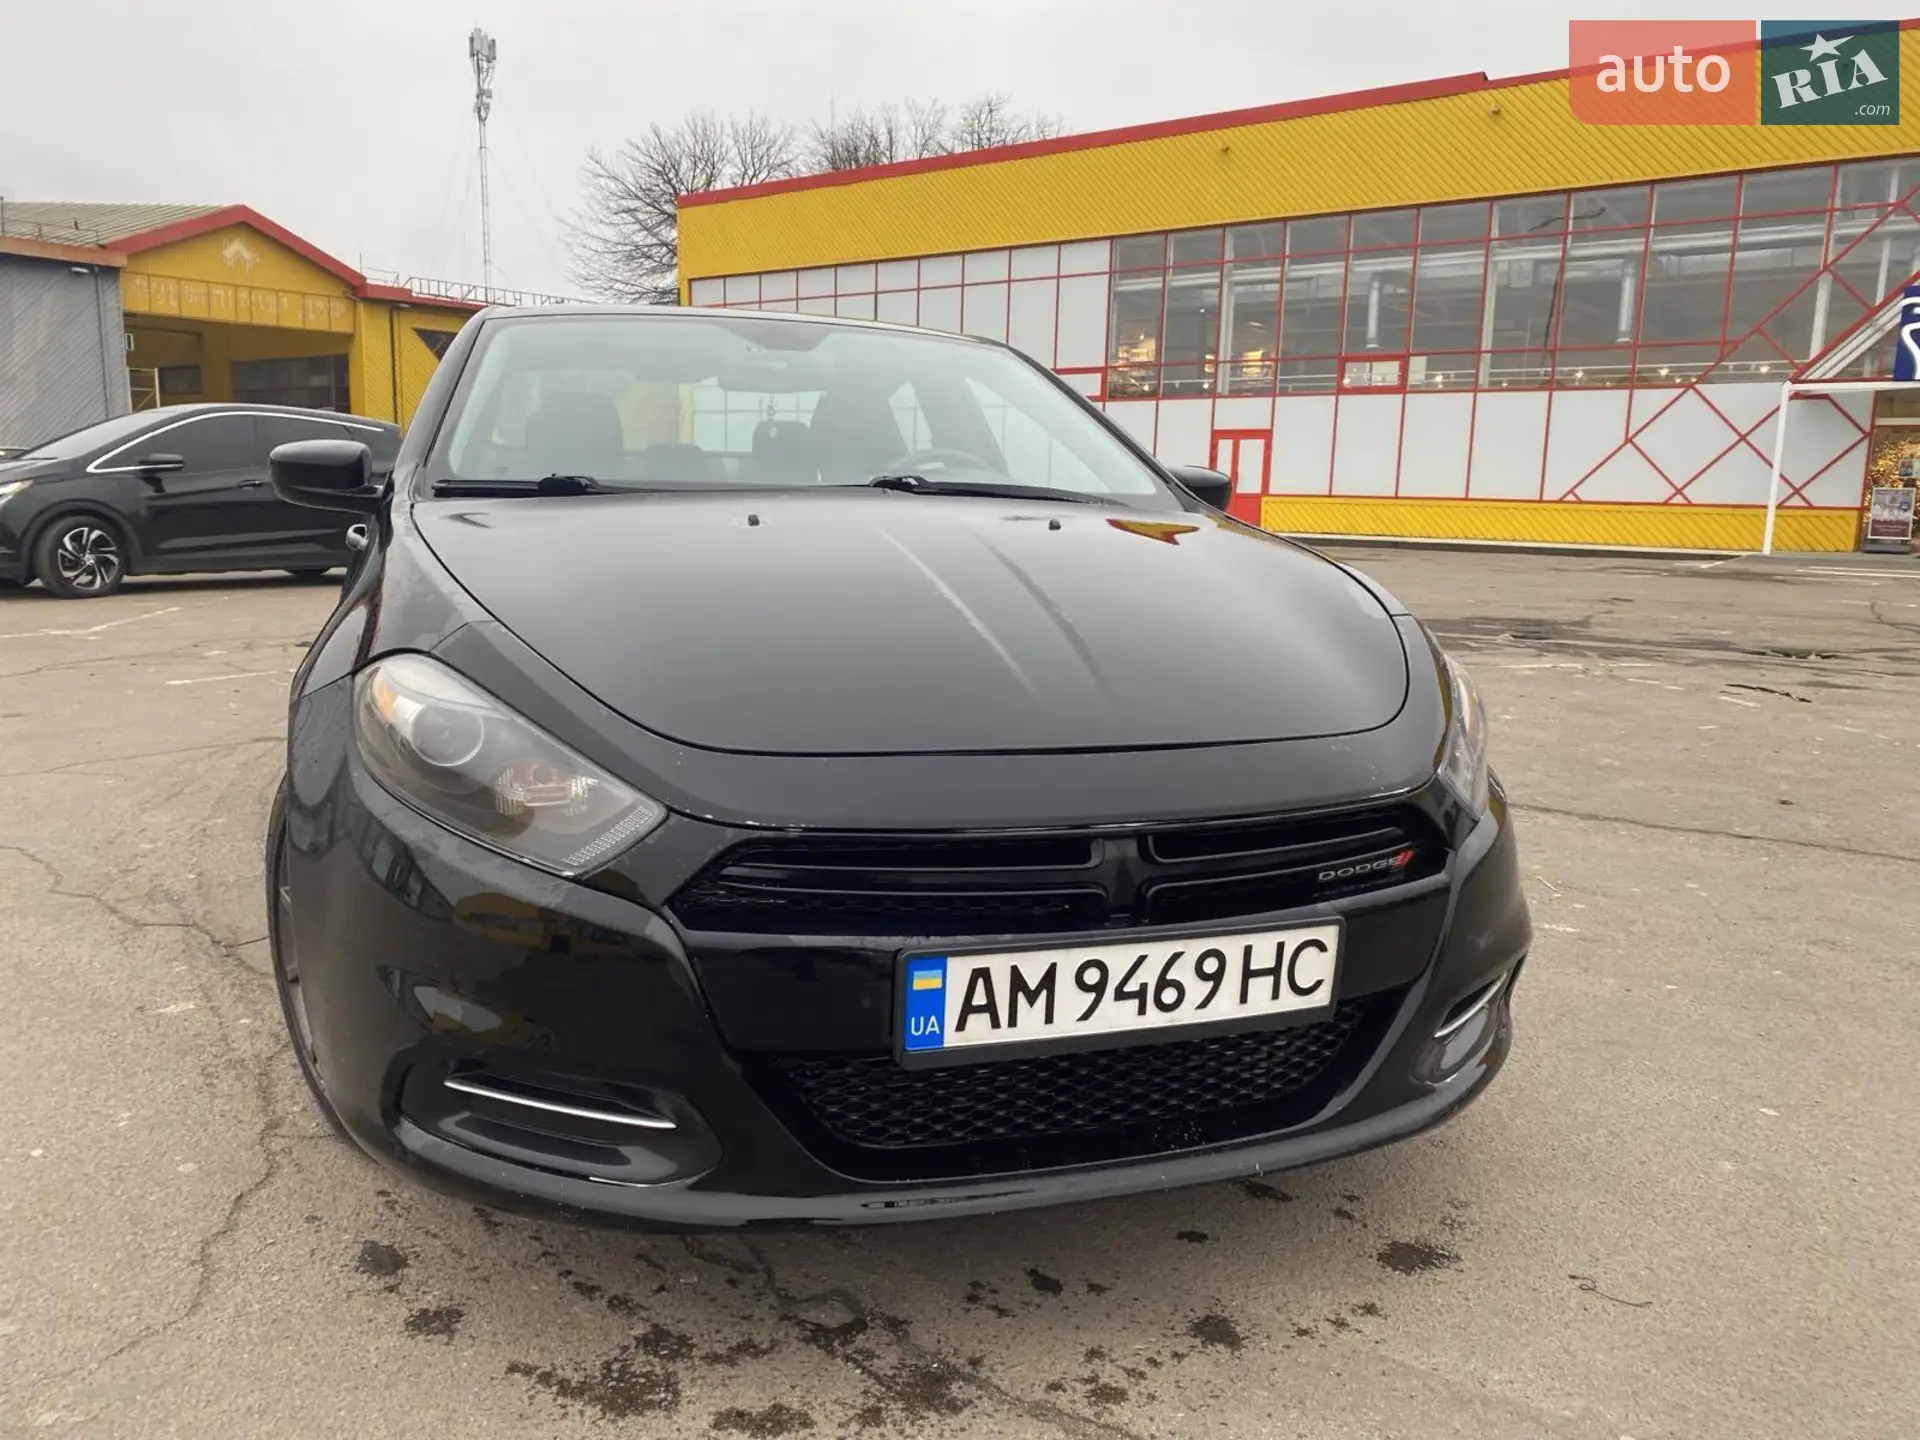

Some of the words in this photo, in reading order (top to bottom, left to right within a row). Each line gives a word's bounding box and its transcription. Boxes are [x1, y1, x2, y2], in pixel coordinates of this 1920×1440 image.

[1318, 857, 1402, 881] DODGE
[954, 963, 1058, 1032] AM
[1074, 948, 1228, 1021] 9469
[1239, 938, 1328, 1004] HC
[910, 1016, 941, 1036] UA
